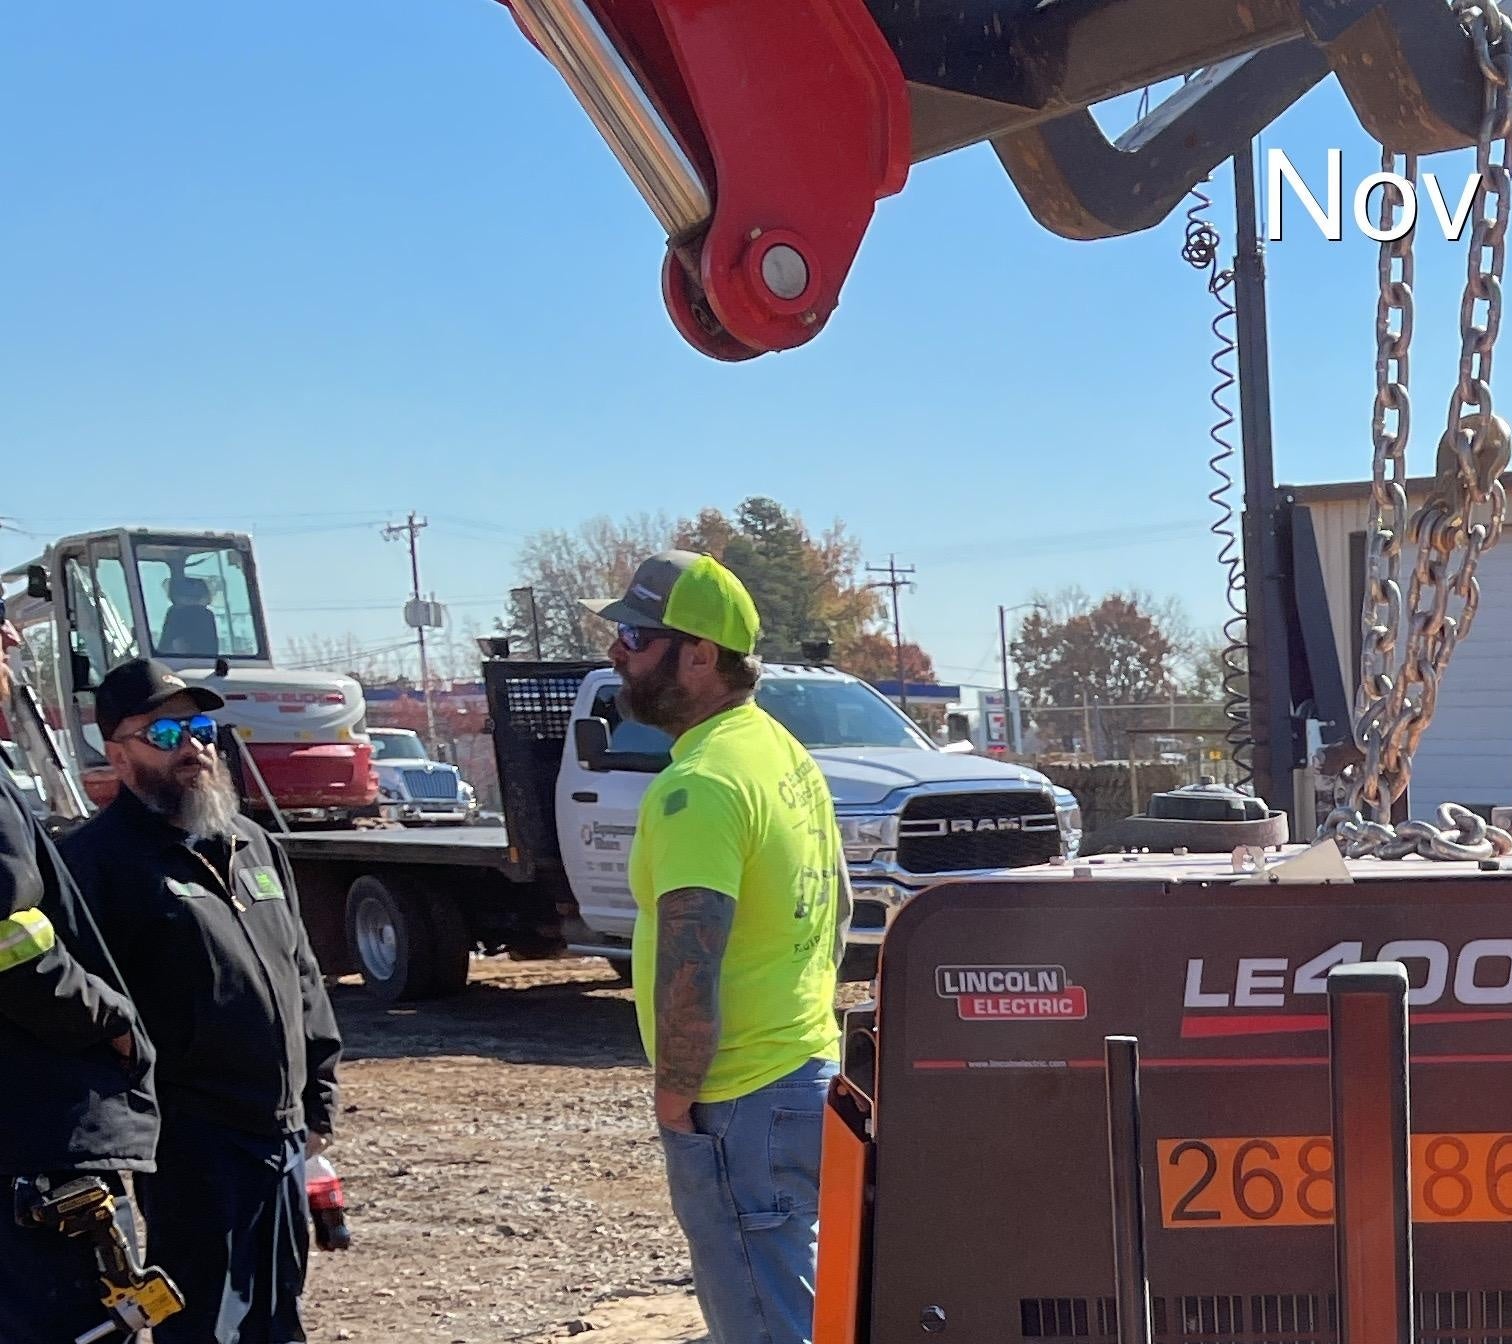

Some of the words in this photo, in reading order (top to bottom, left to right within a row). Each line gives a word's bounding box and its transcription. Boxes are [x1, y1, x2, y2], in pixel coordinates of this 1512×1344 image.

[951, 816, 1020, 832] RAM
[943, 971, 1058, 994] LINCOLN
[974, 998, 1073, 1014] ELECTRIC
